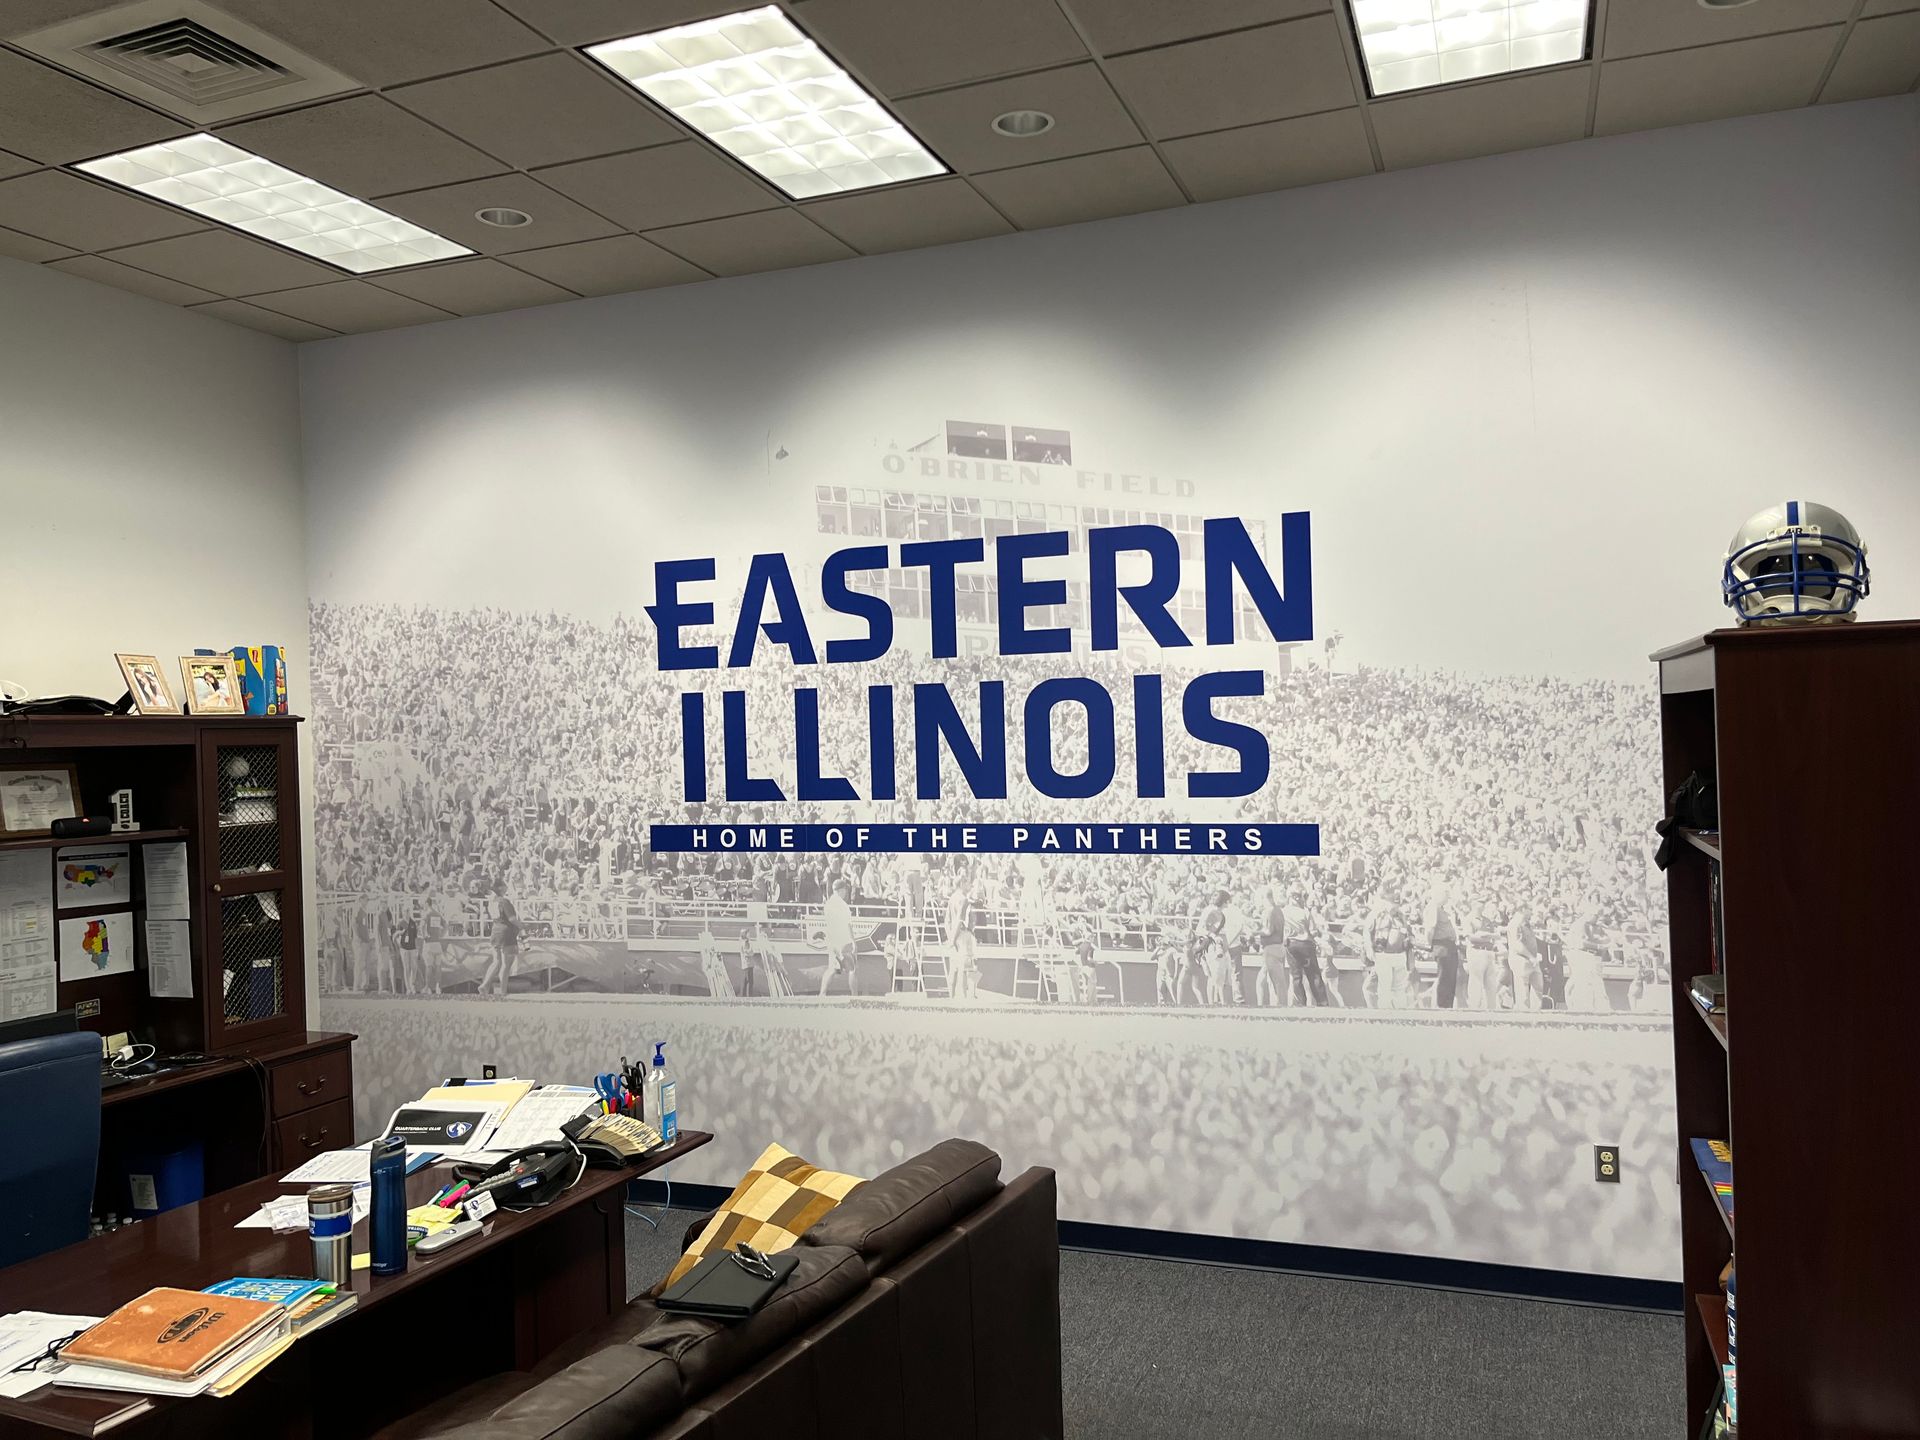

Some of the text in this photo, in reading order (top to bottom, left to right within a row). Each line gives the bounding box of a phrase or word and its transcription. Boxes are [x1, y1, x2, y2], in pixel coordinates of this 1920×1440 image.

[882, 454, 1196, 498] O'BRIEN FIELD
[644, 511, 1313, 671] EASTERN
[681, 670, 1270, 802] ILLINOIS
[692, 828, 1263, 851] HOME OF THE PANTHERS
